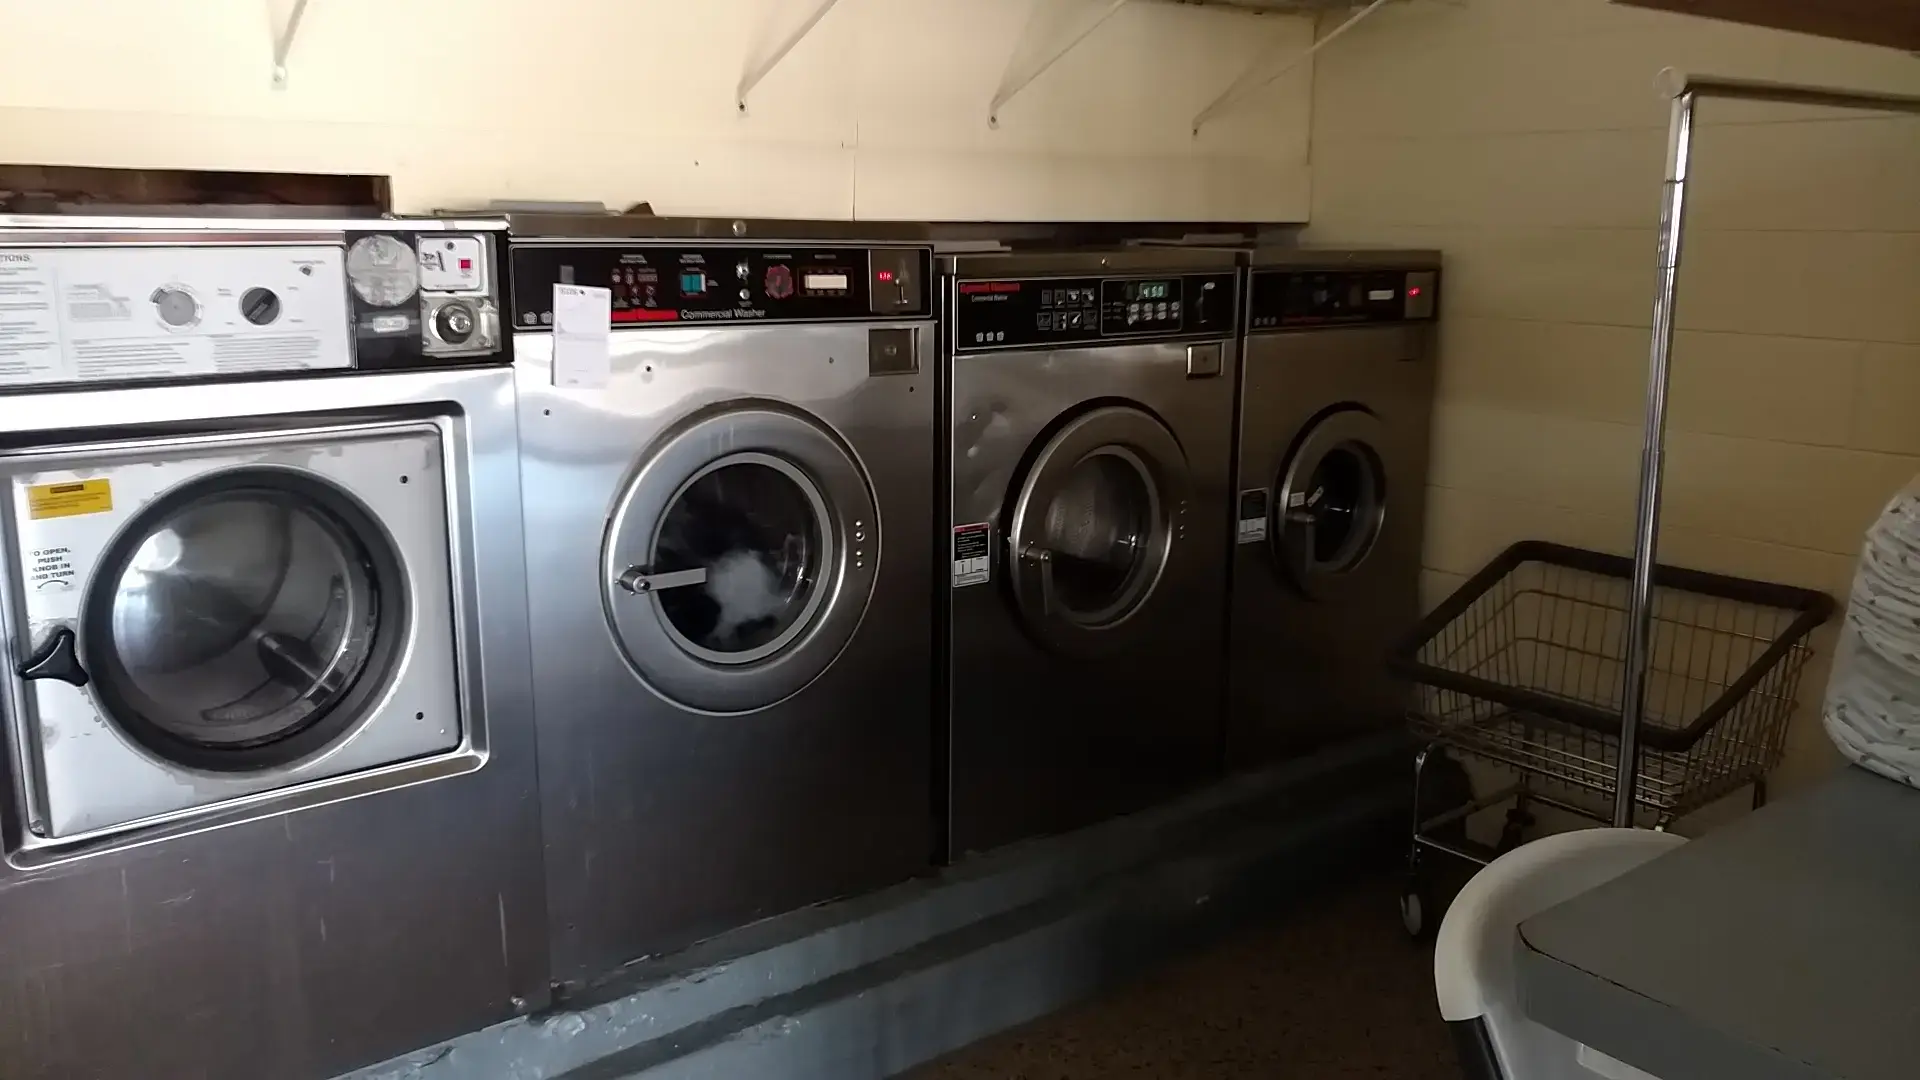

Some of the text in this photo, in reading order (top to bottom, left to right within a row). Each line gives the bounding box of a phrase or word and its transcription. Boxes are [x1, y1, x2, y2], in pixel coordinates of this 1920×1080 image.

[680, 309, 733, 319] Commercial
[733, 308, 766, 319] Washer
[38, 556, 63, 564] PUSH
[50, 570, 75, 578] TURN
